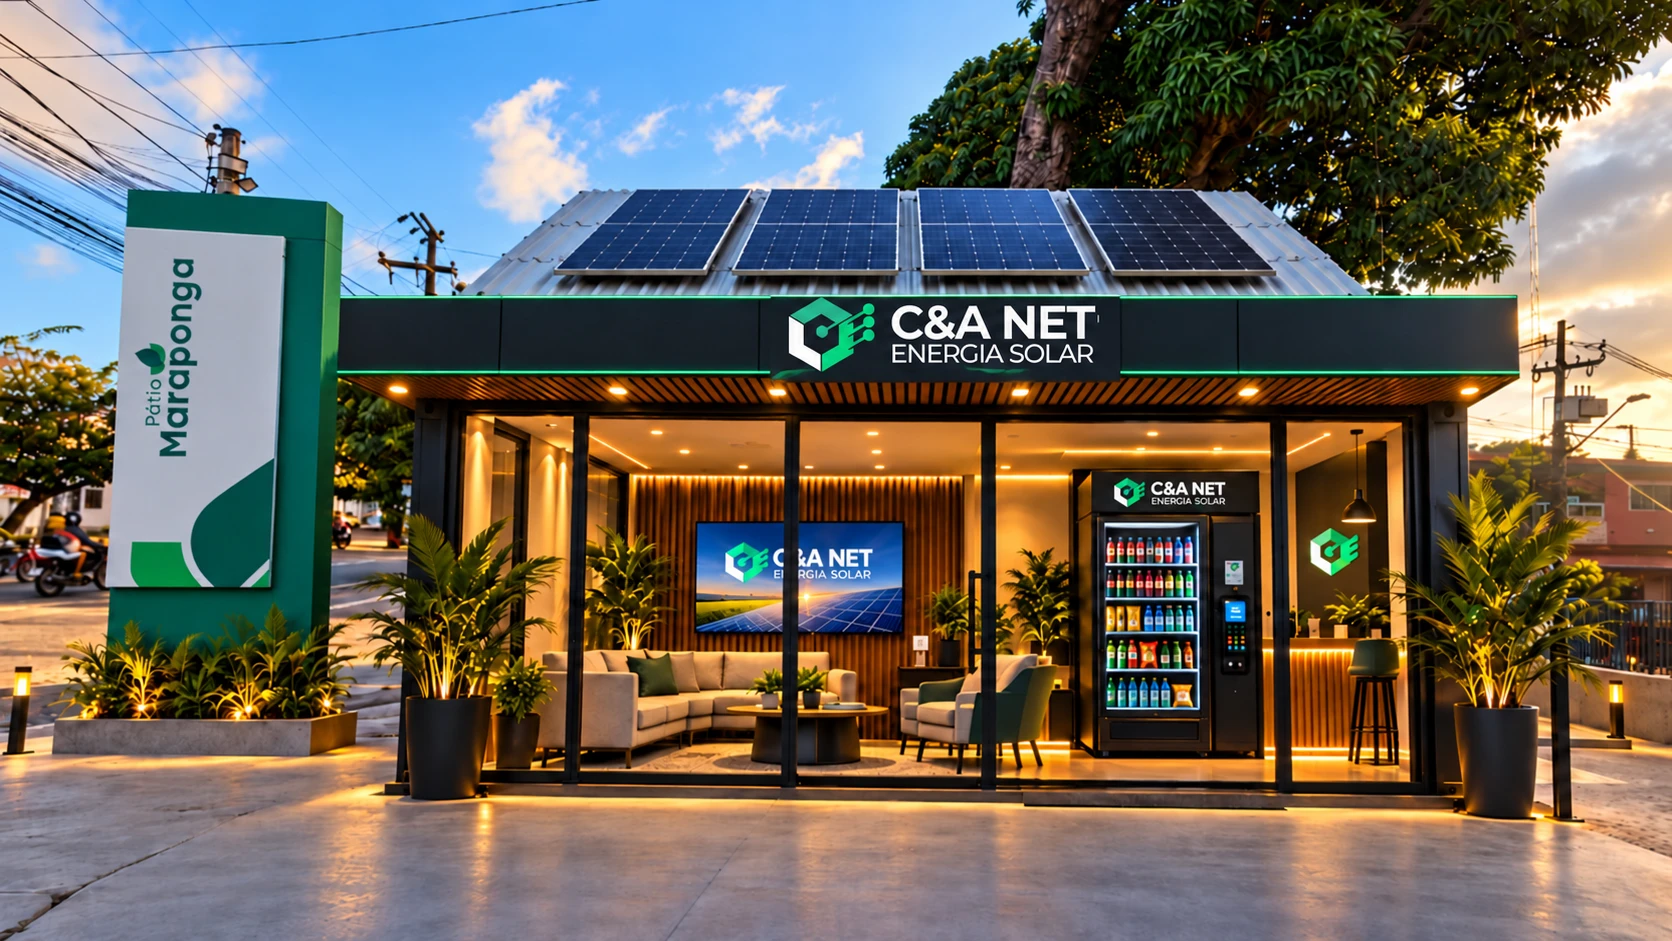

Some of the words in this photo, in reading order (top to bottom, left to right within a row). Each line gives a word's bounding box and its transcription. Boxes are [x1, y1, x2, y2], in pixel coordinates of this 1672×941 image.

[891, 305, 991, 340] C&A
[1004, 305, 1095, 340] NET
[159, 258, 202, 457] Maraponga
[892, 344, 1003, 363] ENERGIA
[1010, 344, 1093, 363] SOLAR
[145, 379, 162, 426] Pátio
[1151, 482, 1188, 495] C&A
[1192, 482, 1225, 495] NET
[1152, 497, 1192, 505] ENERGIA
[1195, 497, 1225, 505] SOLAR
[829, 548, 873, 568] NET
[774, 569, 827, 579] ERGIA
[831, 569, 871, 579] SOLAR
